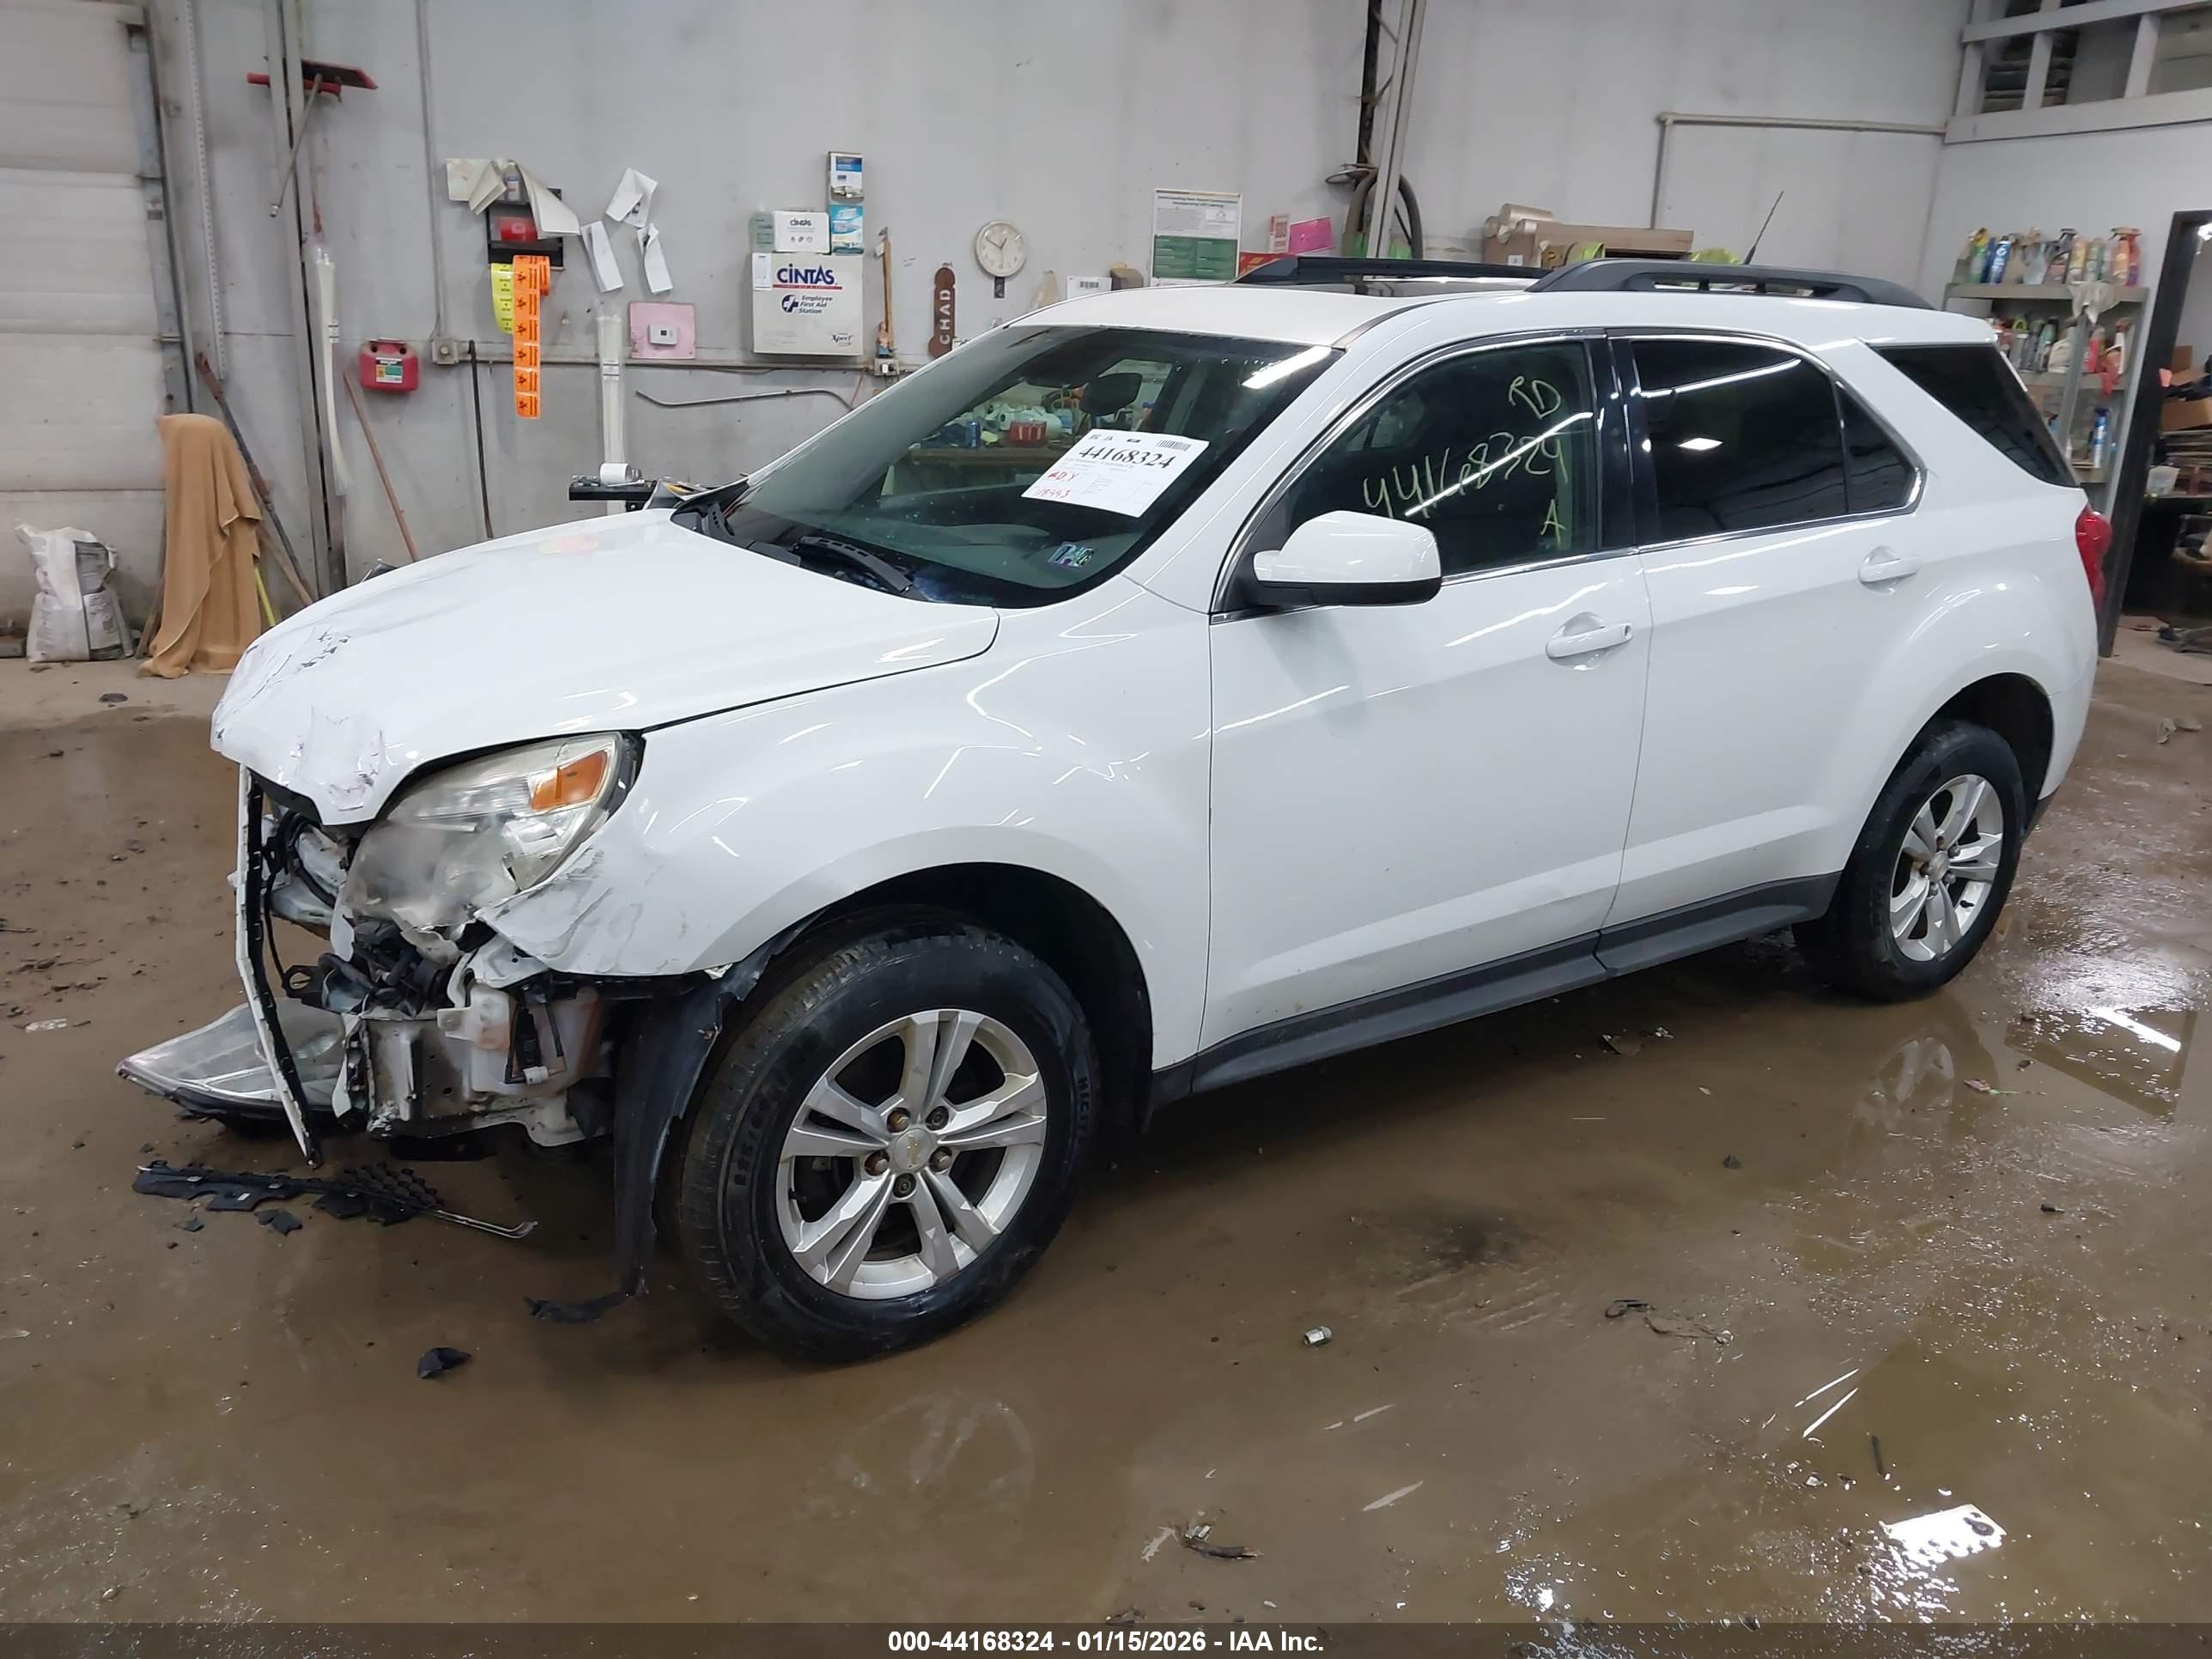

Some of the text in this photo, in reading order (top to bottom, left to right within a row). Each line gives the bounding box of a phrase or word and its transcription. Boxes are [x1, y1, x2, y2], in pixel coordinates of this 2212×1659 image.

[939, 289, 951, 345] CHAD
[1509, 376, 1561, 419] RD
[1079, 445, 1176, 469] 44168324
[1363, 432, 1569, 519] 44168324
[1540, 499, 1567, 546] A
